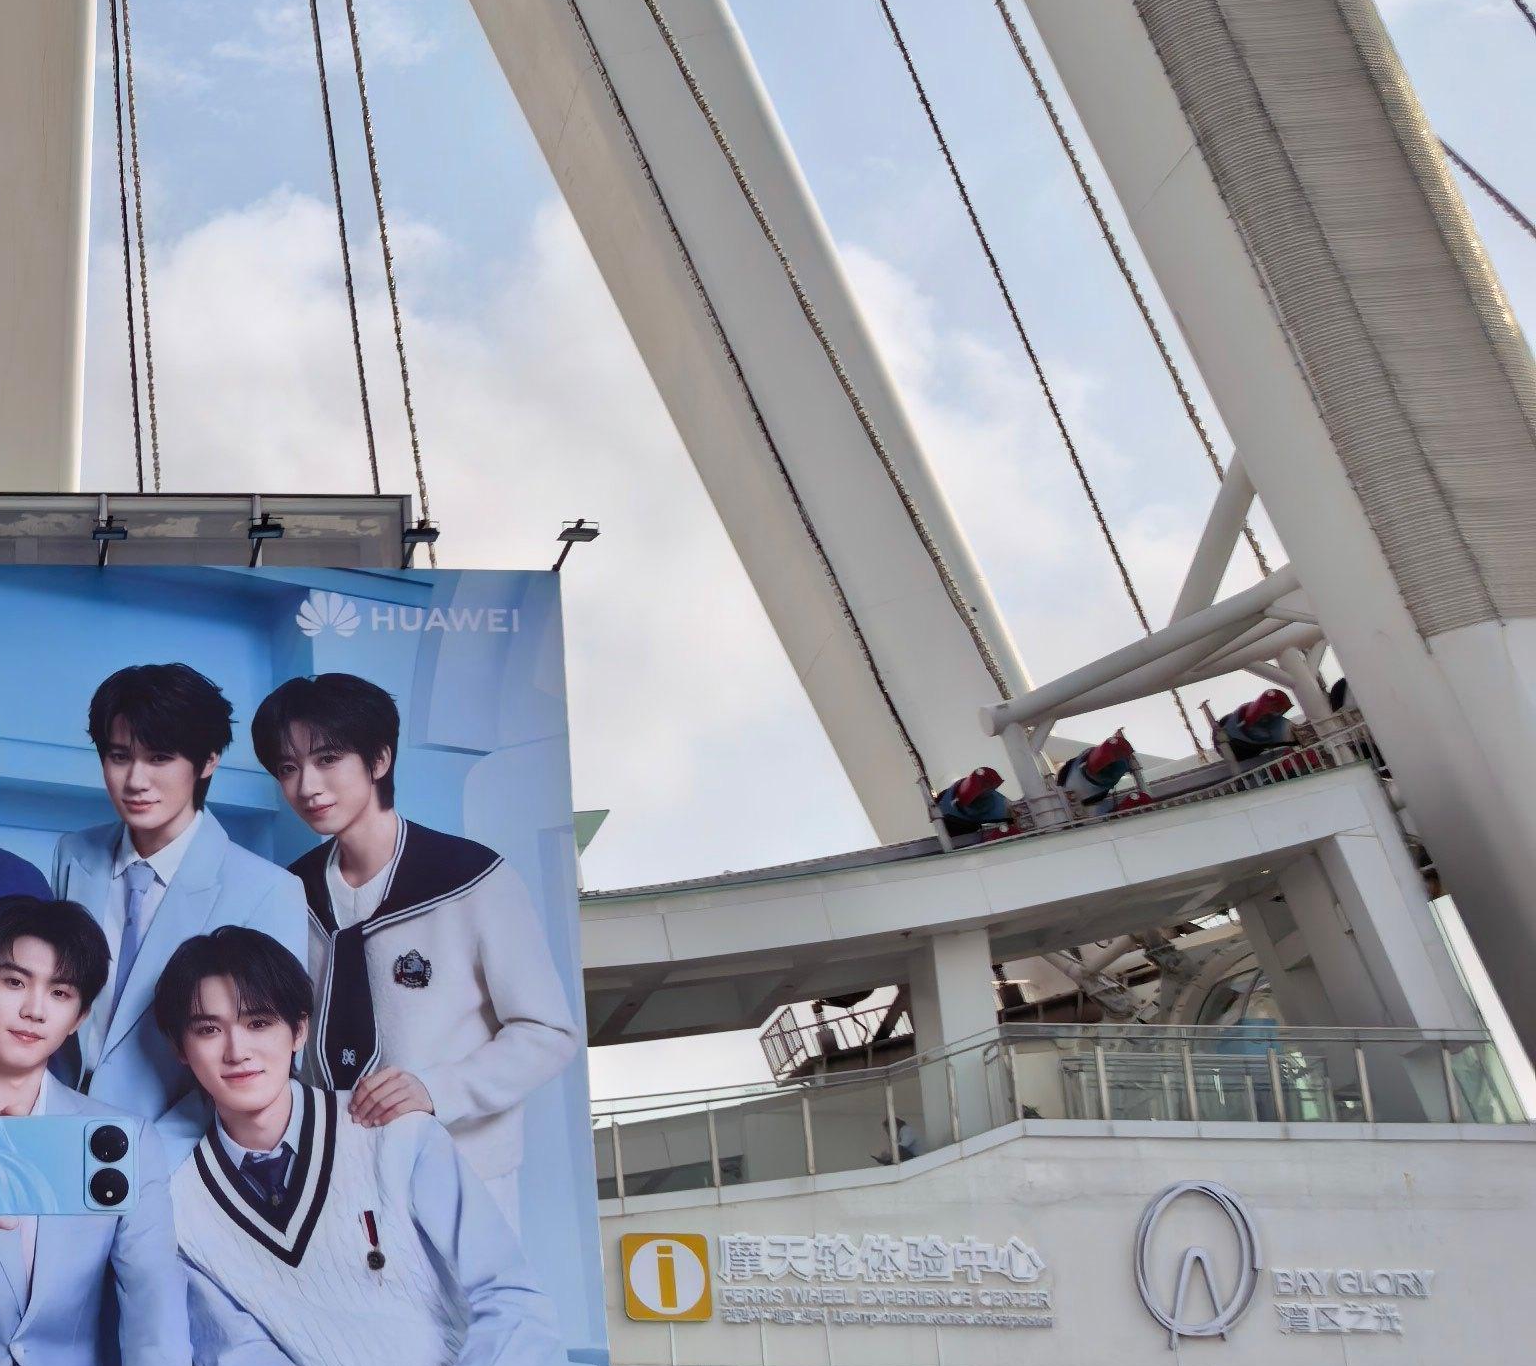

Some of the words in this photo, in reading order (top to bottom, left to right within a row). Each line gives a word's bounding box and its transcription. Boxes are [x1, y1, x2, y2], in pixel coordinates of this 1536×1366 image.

[371, 607, 520, 633] HUAWEI
[717, 1232, 1048, 1285] 摩天轮体验中心
[1271, 1267, 1330, 1296] BAY
[1334, 1267, 1435, 1298] GLORY
[721, 1286, 785, 1306] FERRIS
[788, 1287, 855, 1307] WHEEL
[857, 1287, 973, 1308] EXPERIENCE
[977, 1288, 1051, 1310] CENTER
